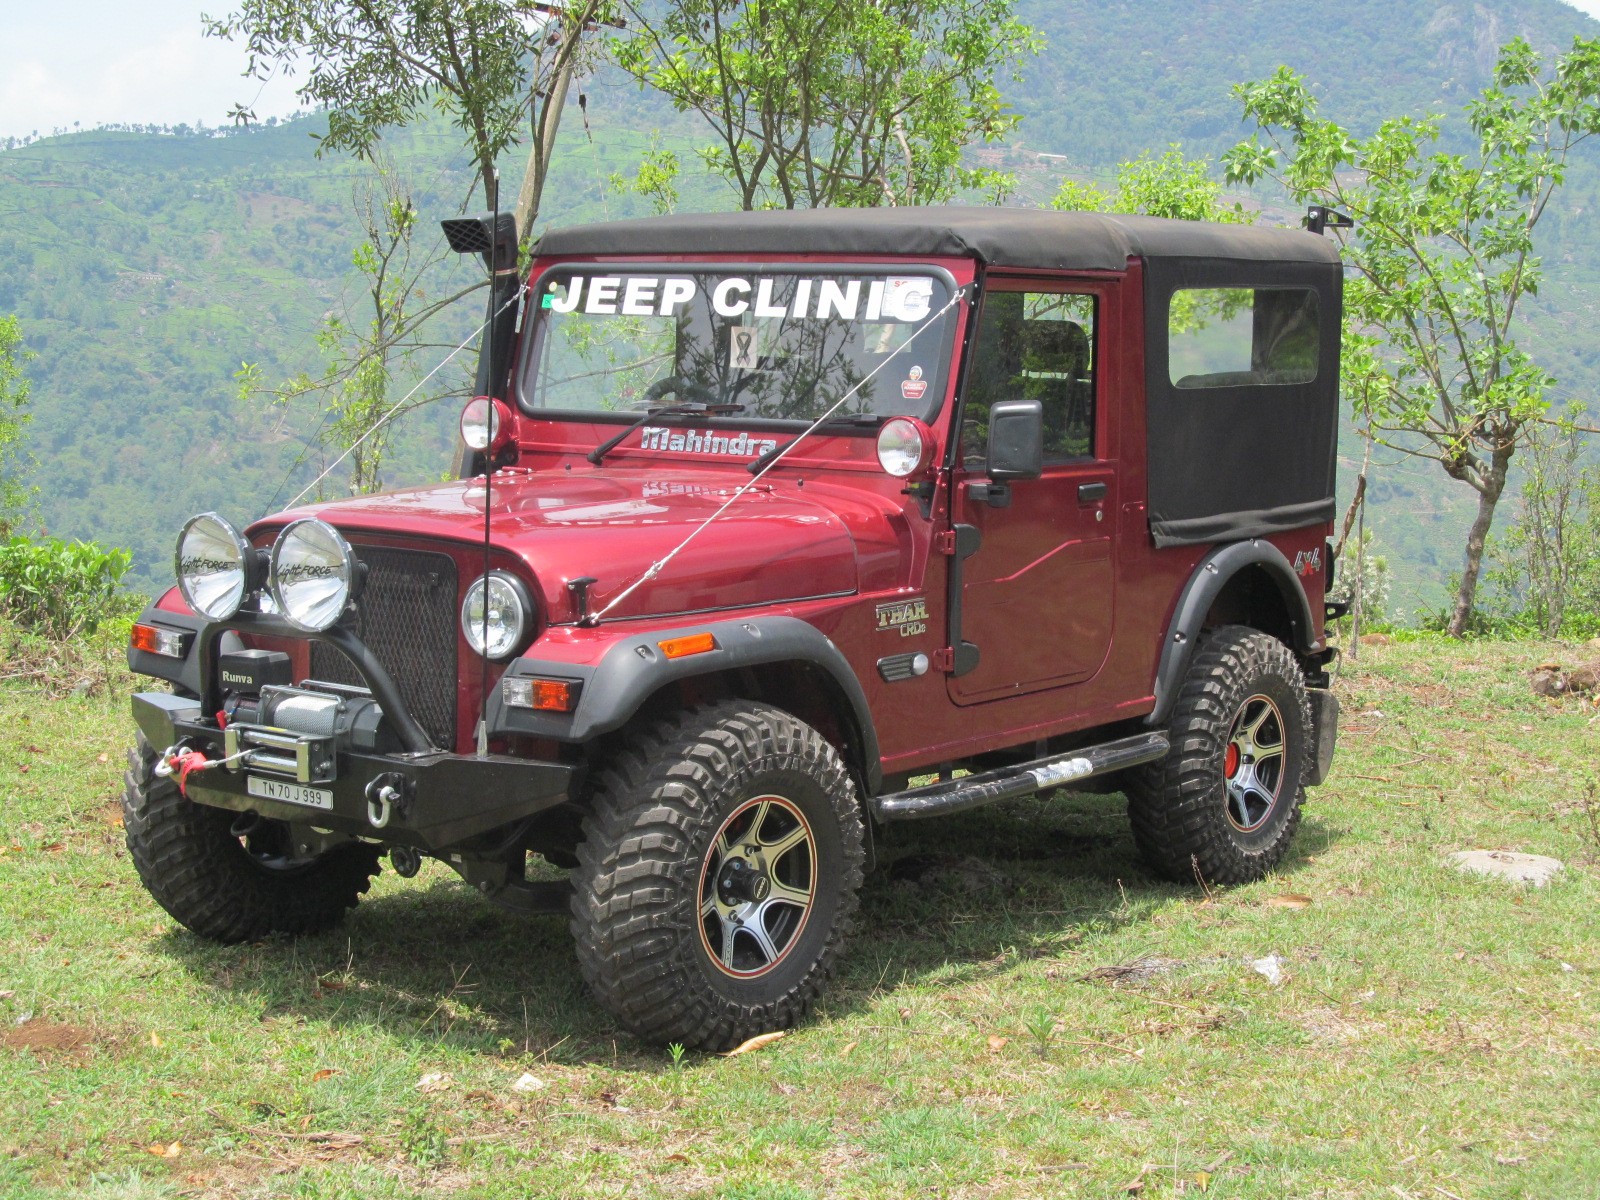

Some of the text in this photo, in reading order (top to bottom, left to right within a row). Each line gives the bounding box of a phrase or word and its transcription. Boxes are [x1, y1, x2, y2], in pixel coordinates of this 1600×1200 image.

[551, 277, 933, 322] JEEP CLINIC
[640, 427, 777, 456] Mahindra
[876, 603, 929, 626] THAR
[900, 622, 926, 637] CRDe
[222, 671, 253, 684] Runva
[262, 782, 322, 805] TN 70 J 999
